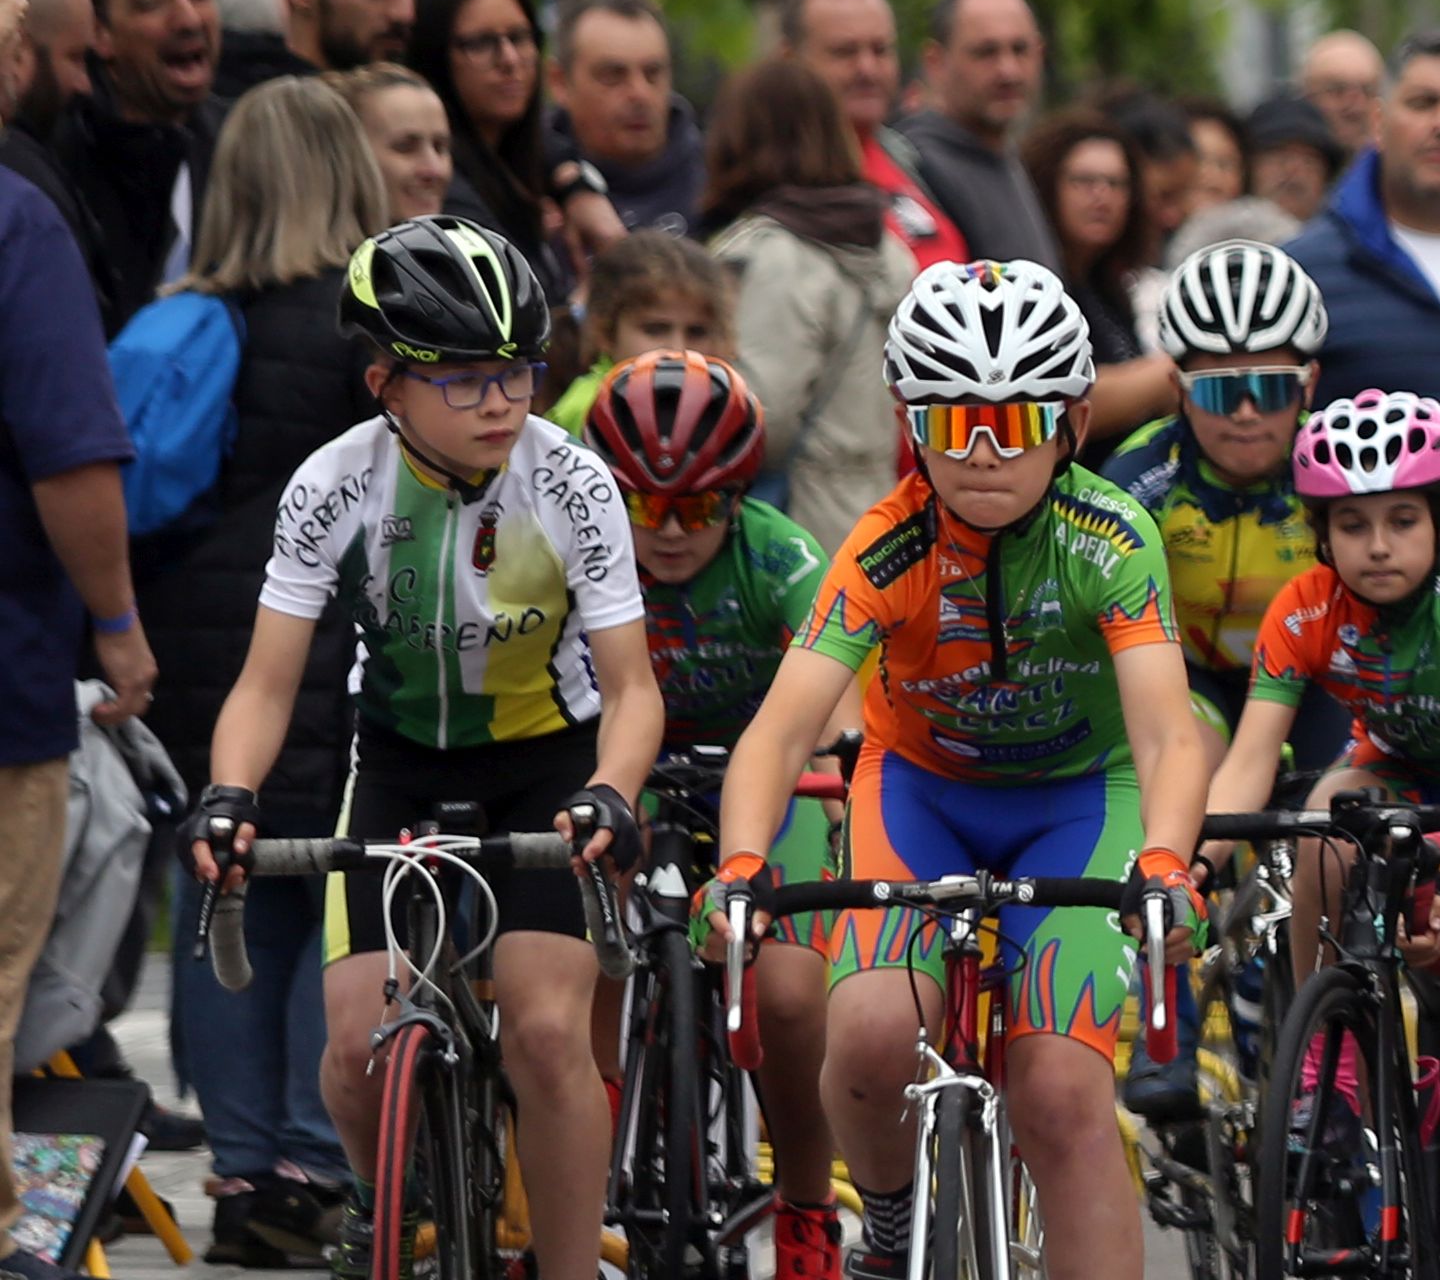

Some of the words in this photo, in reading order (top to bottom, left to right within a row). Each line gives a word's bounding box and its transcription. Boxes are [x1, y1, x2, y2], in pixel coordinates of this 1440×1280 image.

[545, 445, 613, 515] AYTO.
[1077, 487, 1138, 522] QUESOS
[530, 466, 612, 582] CARREÑO
[900, 661, 991, 693] Escuel
